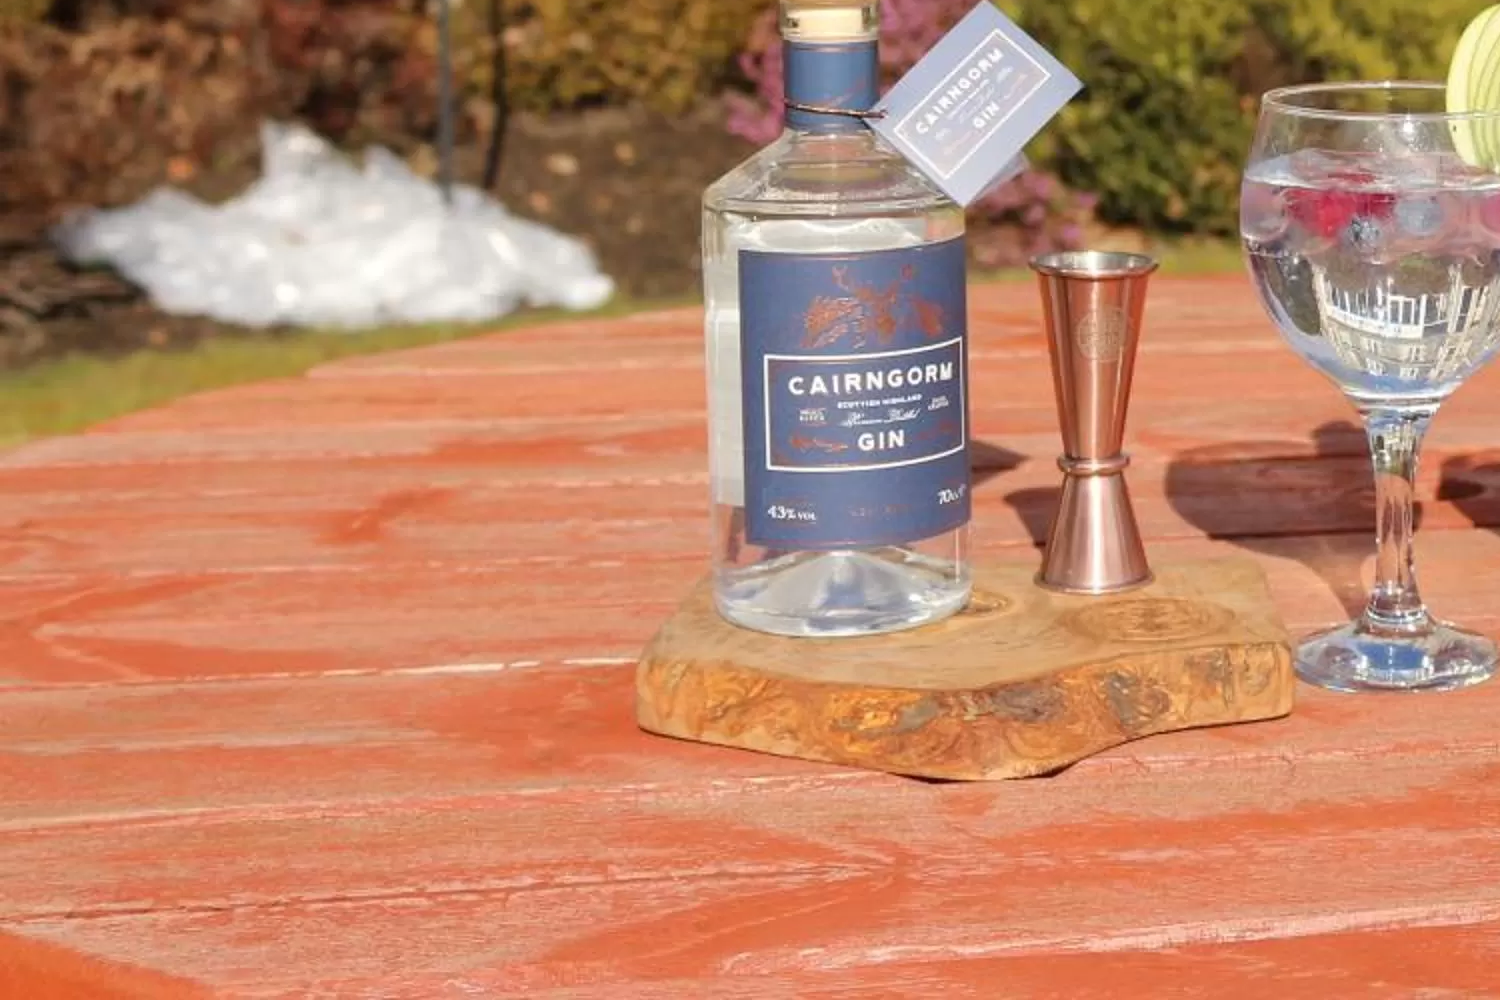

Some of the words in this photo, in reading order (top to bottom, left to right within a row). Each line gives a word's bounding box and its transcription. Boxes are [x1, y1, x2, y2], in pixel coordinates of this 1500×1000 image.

[915, 48, 1004, 133] CAIRNGORM
[788, 362, 954, 396] CAIRNGORM
[858, 429, 905, 451] GIN
[768, 504, 796, 519] 43%
